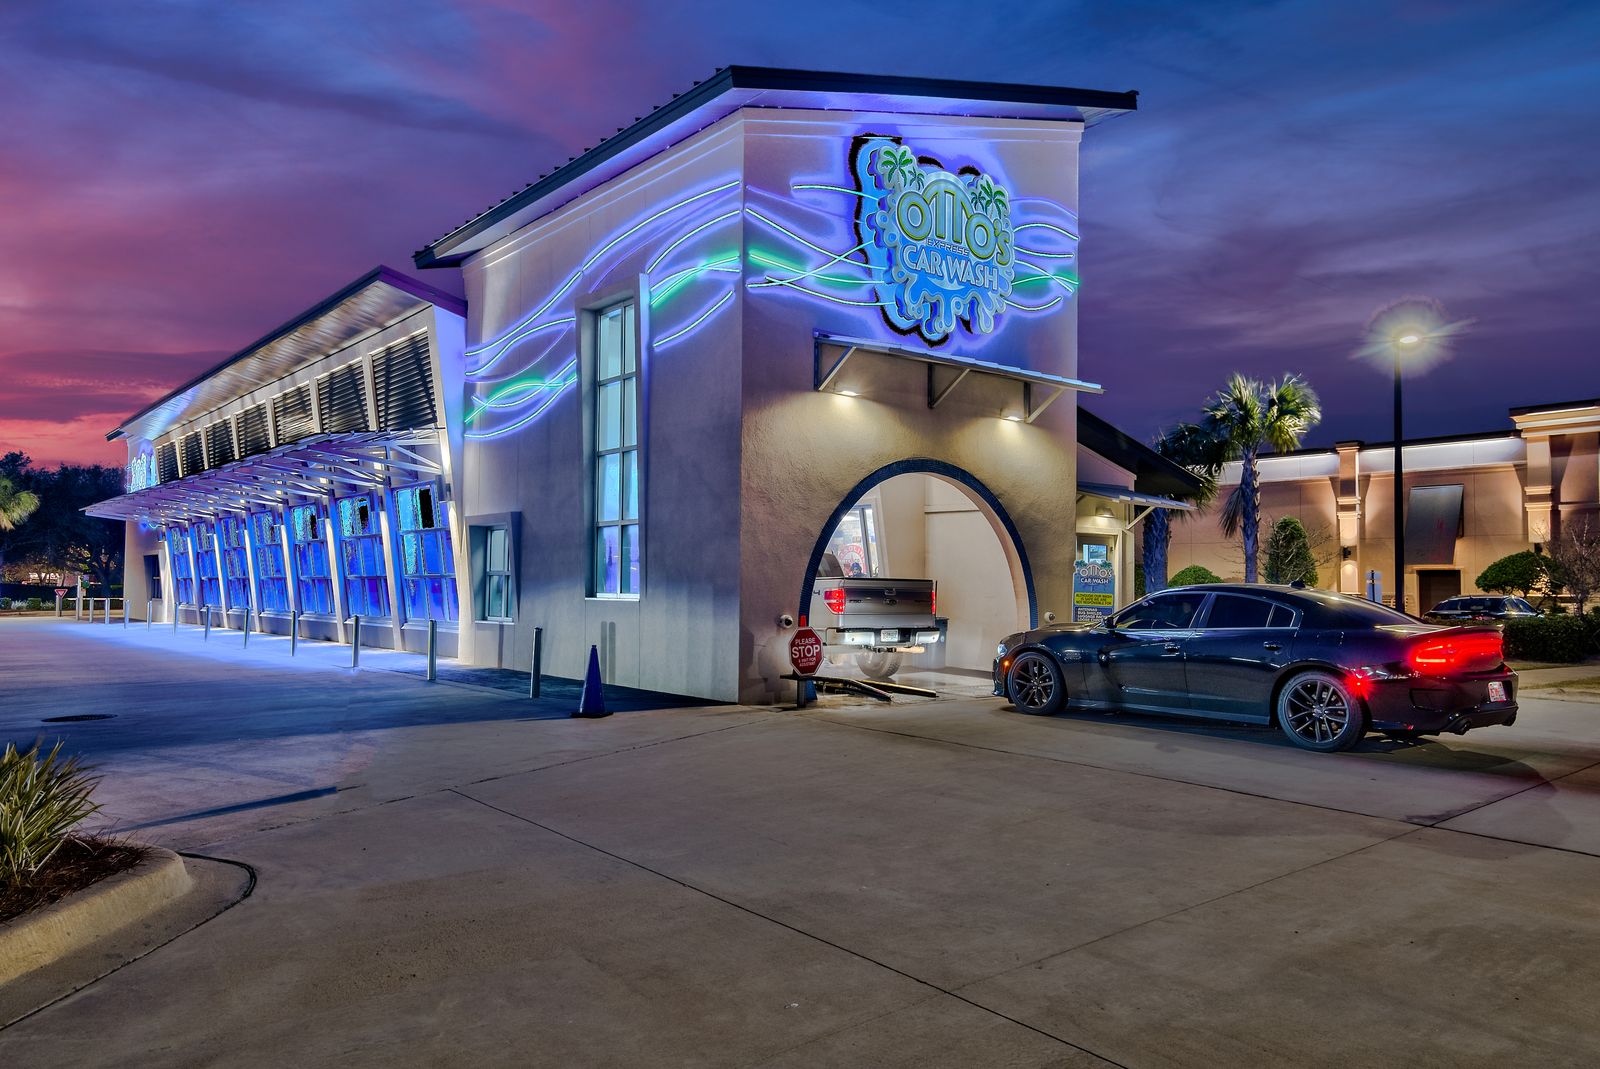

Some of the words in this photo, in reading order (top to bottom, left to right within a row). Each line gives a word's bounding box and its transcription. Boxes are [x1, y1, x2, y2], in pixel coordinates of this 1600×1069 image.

[926, 240, 970, 256] EXPRESS
[903, 245, 943, 277] CAR
[947, 255, 999, 291] WASH
[795, 637, 816, 645] PLEASE
[792, 645, 820, 658] STOP
